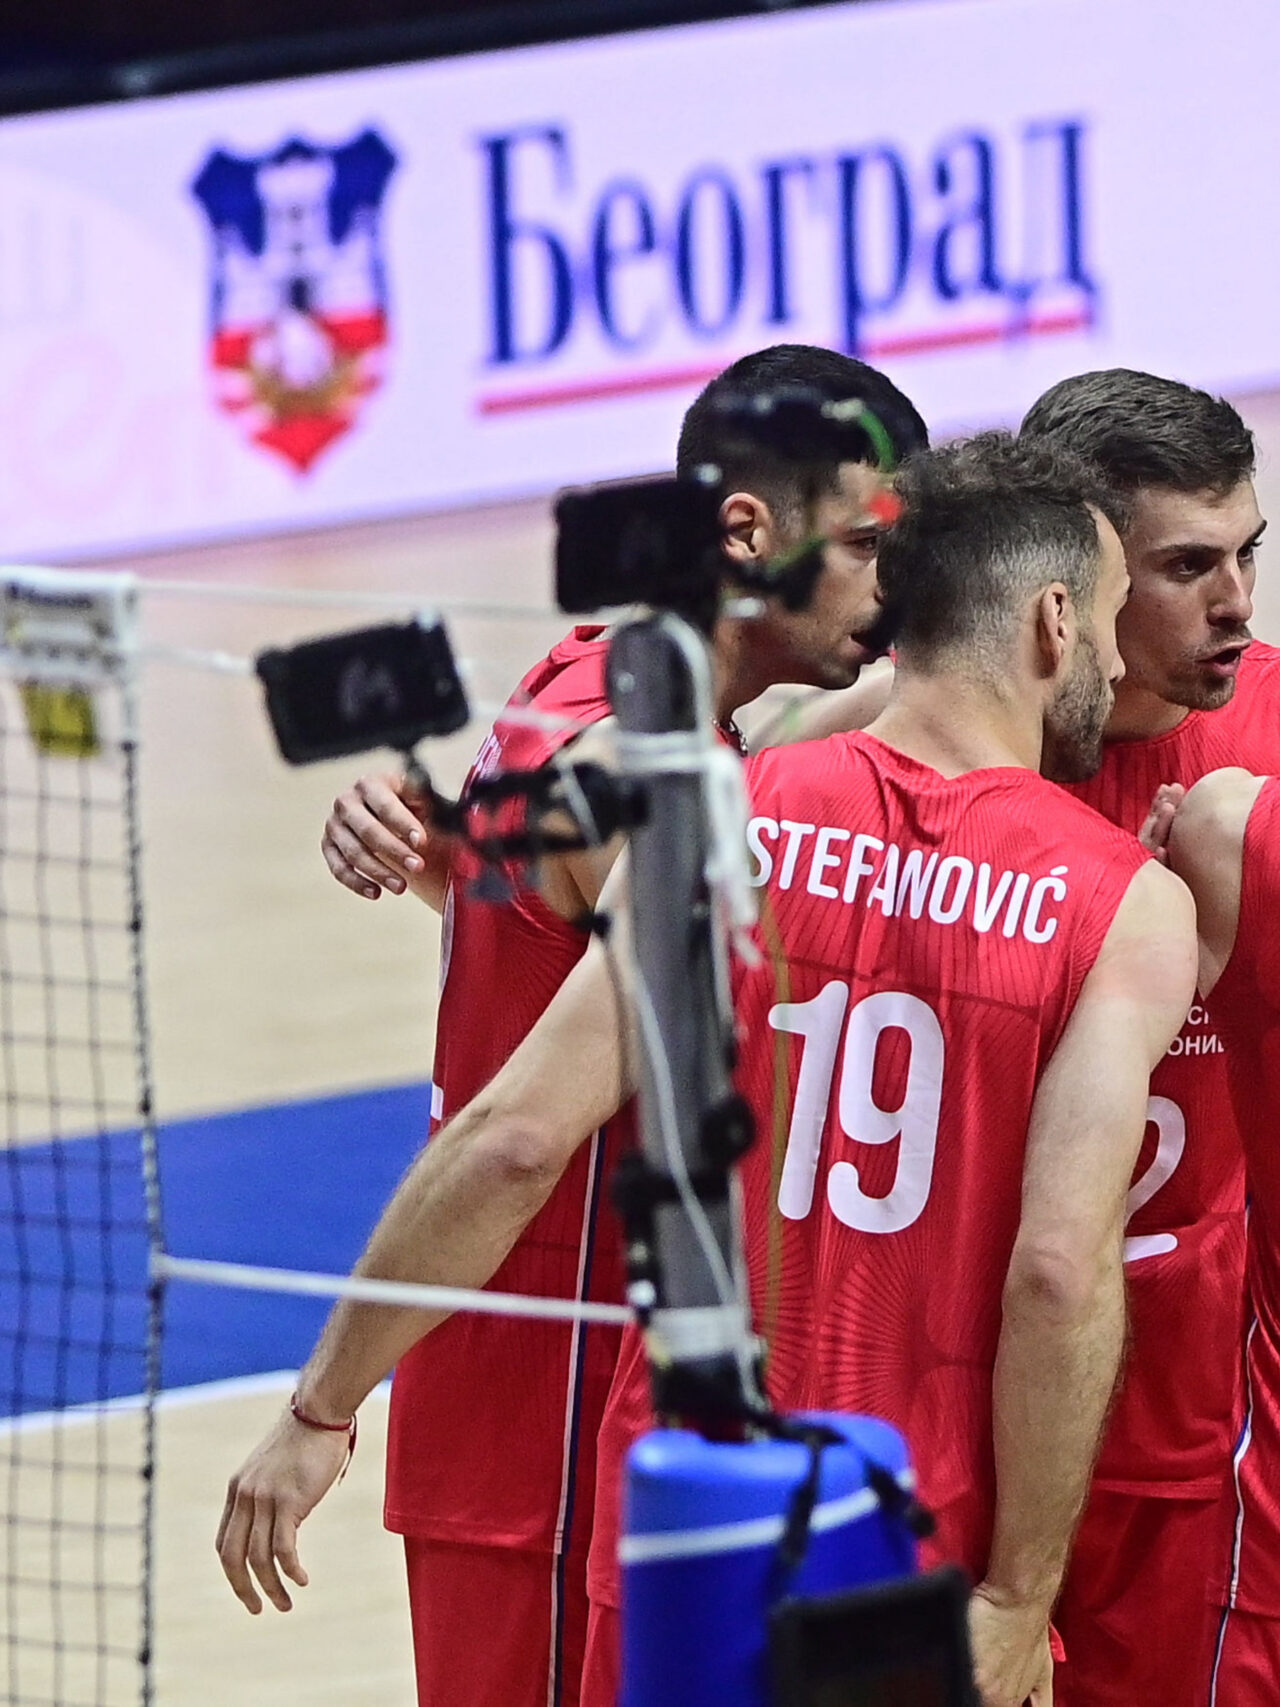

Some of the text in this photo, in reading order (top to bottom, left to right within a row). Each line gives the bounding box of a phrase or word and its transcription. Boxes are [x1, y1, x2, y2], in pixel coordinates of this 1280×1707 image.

[477, 112, 1106, 368] Београд
[746, 816, 1068, 944] STEFANOVIĆ
[768, 980, 945, 1234] 19
